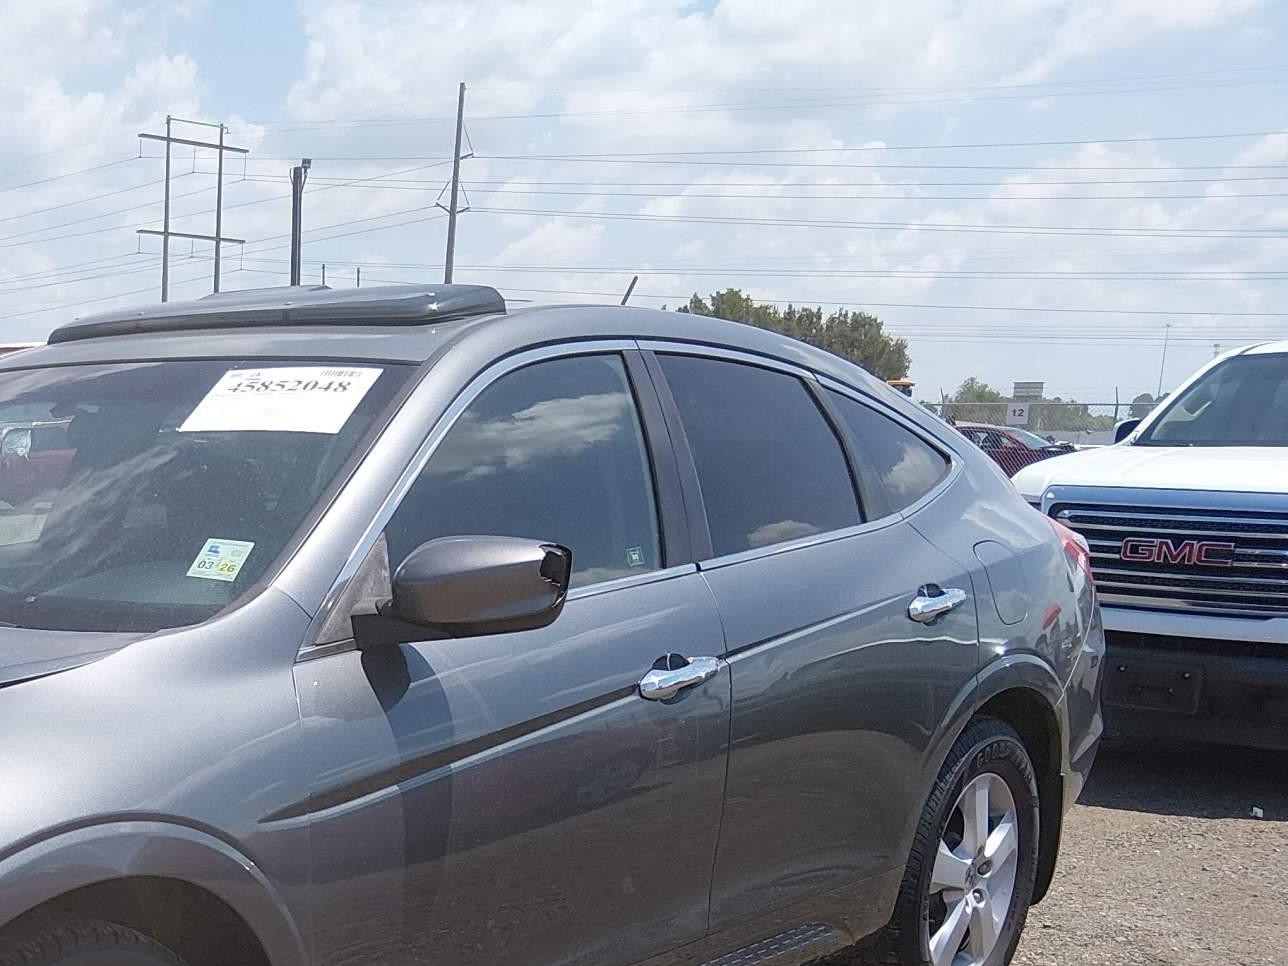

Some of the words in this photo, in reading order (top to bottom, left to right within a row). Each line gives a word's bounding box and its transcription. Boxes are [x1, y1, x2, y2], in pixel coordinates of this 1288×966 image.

[226, 379, 352, 393] 45852048
[1012, 408, 1025, 417] 12
[1120, 537, 1235, 567] GMC
[197, 560, 214, 570] 03
[219, 563, 237, 573] 26
